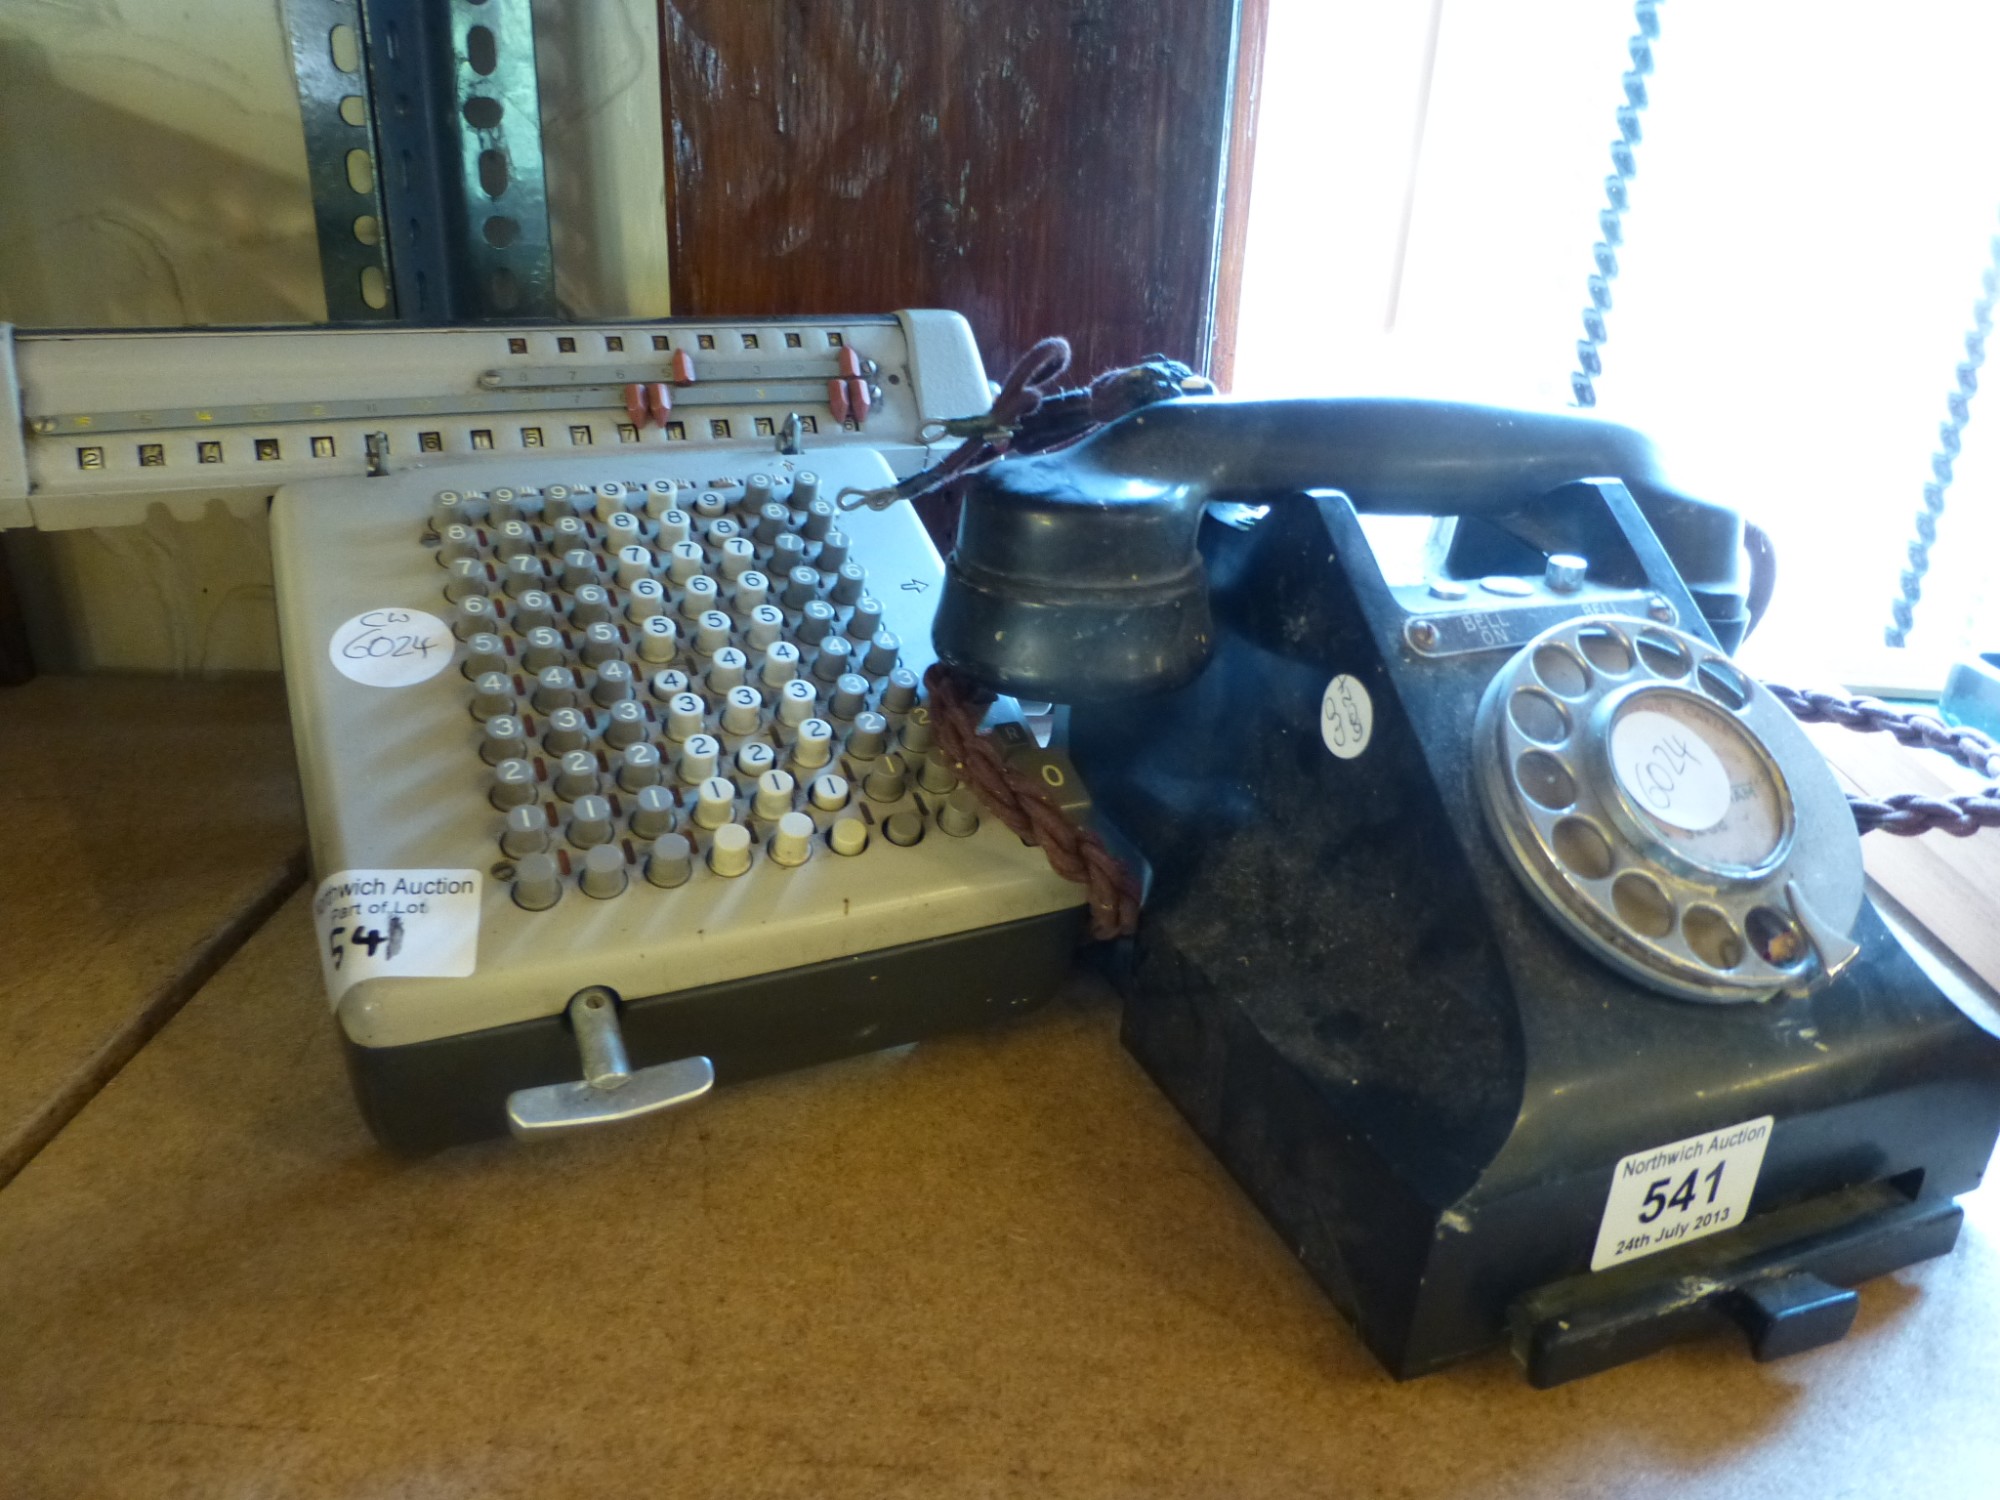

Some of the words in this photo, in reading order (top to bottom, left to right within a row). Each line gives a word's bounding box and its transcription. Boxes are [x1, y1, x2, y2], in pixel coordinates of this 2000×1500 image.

[83, 452, 98, 466] 2
[526, 432, 537, 444] 5
[573, 431, 585, 442] 7
[622, 429, 633, 440] 7
[441, 492, 458, 504] 9
[496, 489, 512, 502] 9
[550, 486, 566, 499] 9
[604, 484, 618, 496] 9
[655, 481, 670, 492] 9
[705, 494, 718, 506] 9
[754, 475, 768, 487] 9
[800, 473, 815, 484] 9
[448, 526, 466, 539] 8
[505, 522, 522, 536] 8
[560, 519, 578, 532] 8
[614, 514, 630, 526] 8
[668, 511, 682, 523] 8
[717, 522, 732, 533] 8
[766, 506, 780, 518] 8
[815, 502, 830, 513] 8
[457, 560, 472, 574] 7
[514, 556, 530, 570] 7
[572, 551, 585, 566] 7
[626, 548, 639, 562] 7
[680, 544, 692, 556] 7
[732, 540, 742, 552] 7
[783, 536, 794, 548] 7
[832, 532, 842, 544] 7
[465, 598, 480, 612] 6
[525, 592, 542, 607] 6
[583, 587, 598, 601] 6
[638, 581, 654, 594] 6
[693, 578, 708, 591] 6
[745, 574, 760, 586] 6
[796, 570, 811, 582] 6
[846, 564, 860, 576] 6
[343, 629, 439, 659] 6024
[476, 636, 492, 651] 5
[536, 630, 552, 645] 5
[595, 625, 611, 640] 5
[652, 620, 667, 633] 5
[708, 614, 722, 628] 5
[762, 609, 775, 621] 5
[813, 604, 828, 617] 5
[863, 599, 878, 612] 5
[1459, 614, 1511, 633] BELL
[1481, 629, 1510, 645] ON
[484, 675, 500, 689] 4
[546, 669, 562, 682] 4
[606, 662, 622, 677] 4
[664, 672, 679, 686] 4
[723, 651, 737, 664] 4
[776, 646, 790, 658] 4
[828, 640, 844, 652] 4
[881, 634, 894, 646] 4
[496, 718, 513, 735] 3
[558, 710, 576, 727] 3
[620, 703, 637, 719] 3
[680, 696, 695, 711] 3
[737, 690, 752, 704] 3
[792, 683, 807, 697] 3
[847, 678, 860, 692] 3
[899, 670, 910, 682] 3
[504, 762, 523, 779] 2
[570, 753, 588, 770] 2
[632, 746, 650, 762] 2
[692, 738, 709, 754] 2
[749, 745, 766, 760] 2
[808, 721, 825, 736] 2
[863, 715, 878, 730] 2
[914, 708, 929, 724] 2
[522, 808, 530, 827] 1
[586, 800, 595, 817] 1
[651, 790, 659, 807] 1
[711, 781, 720, 798] 1
[772, 774, 780, 790] 1
[827, 778, 836, 794] 1
[885, 756, 894, 772] 1
[1635, 735, 1702, 809] 6024
[368, 901, 389, 914] of
[394, 901, 427, 914] Lot
[392, 878, 474, 895] Auction
[1622, 1141, 1704, 1178] Northwich
[1706, 1124, 1767, 1154] Auction
[1638, 1160, 1726, 1224] 541
[1614, 1235, 1650, 1255] 24th
[1654, 1222, 1690, 1243] July
[1693, 1207, 1731, 1231] 2013
